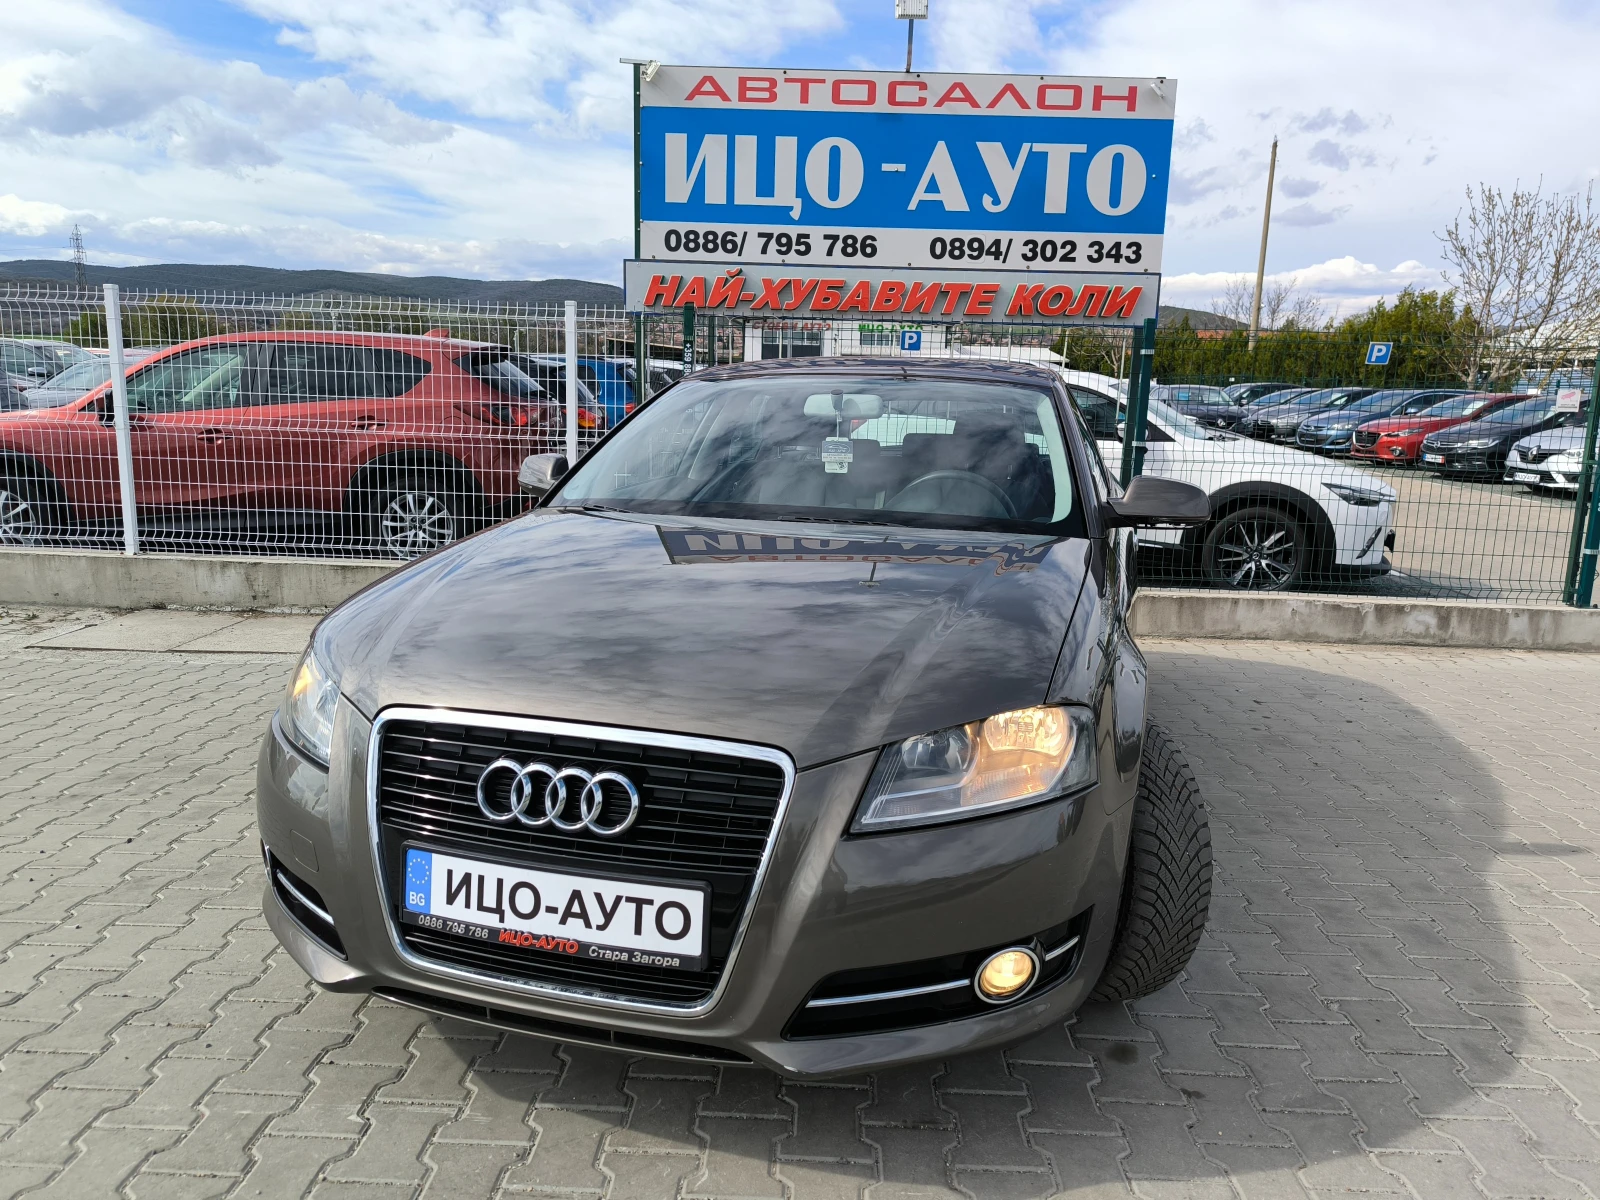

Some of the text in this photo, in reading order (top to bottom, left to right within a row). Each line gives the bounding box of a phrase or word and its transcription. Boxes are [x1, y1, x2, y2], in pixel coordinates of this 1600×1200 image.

[684, 75, 1138, 112] АВТОСАЛОН
[664, 229, 1142, 264] 0886/ 795 786 0894/ 302 343
[644, 267, 1143, 318] НАЙ-ХУБАВИТЕ КОЛИ
[409, 891, 425, 906] BG
[446, 868, 692, 941] ИЦО-АУТО
[418, 915, 488, 939] 0886 795 786
[498, 928, 579, 954] ИЦО-АУТО
[588, 946, 680, 967] Стара Загора
